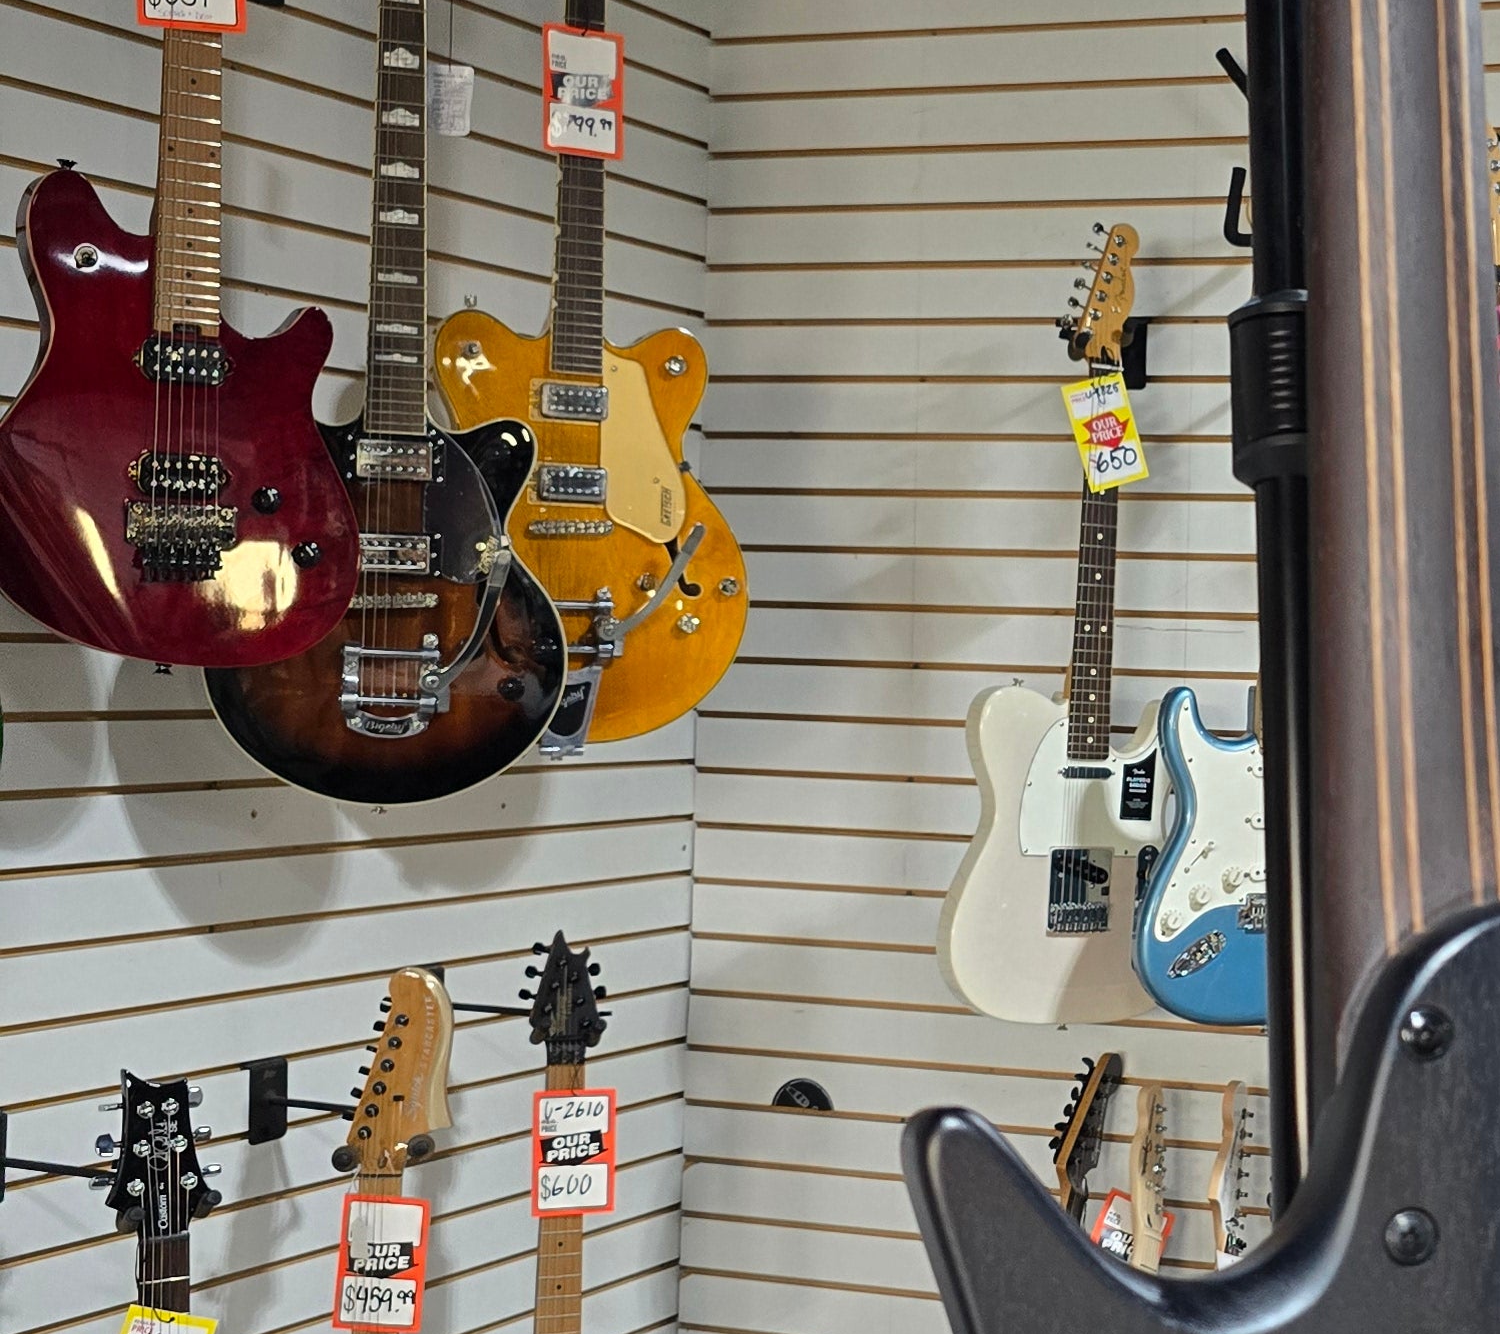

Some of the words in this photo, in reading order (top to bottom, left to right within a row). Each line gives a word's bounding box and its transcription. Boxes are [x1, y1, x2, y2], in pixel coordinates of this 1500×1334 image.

[562, 74, 599, 88] OUR
[557, 86, 609, 101] PRICE
[1092, 416, 1119, 431] OUR
[1091, 426, 1124, 444] PRICE
[551, 1132, 591, 1149] OUR
[545, 1142, 600, 1163] PRICE
[540, 1173, 592, 1202] $600
[157, 1194, 169, 1230] Custom
[1110, 1230, 1134, 1244] OU
[1101, 1238, 1134, 1255] PRIC
[353, 1255, 410, 1271] PRICE
[343, 1284, 416, 1314] $459.99
